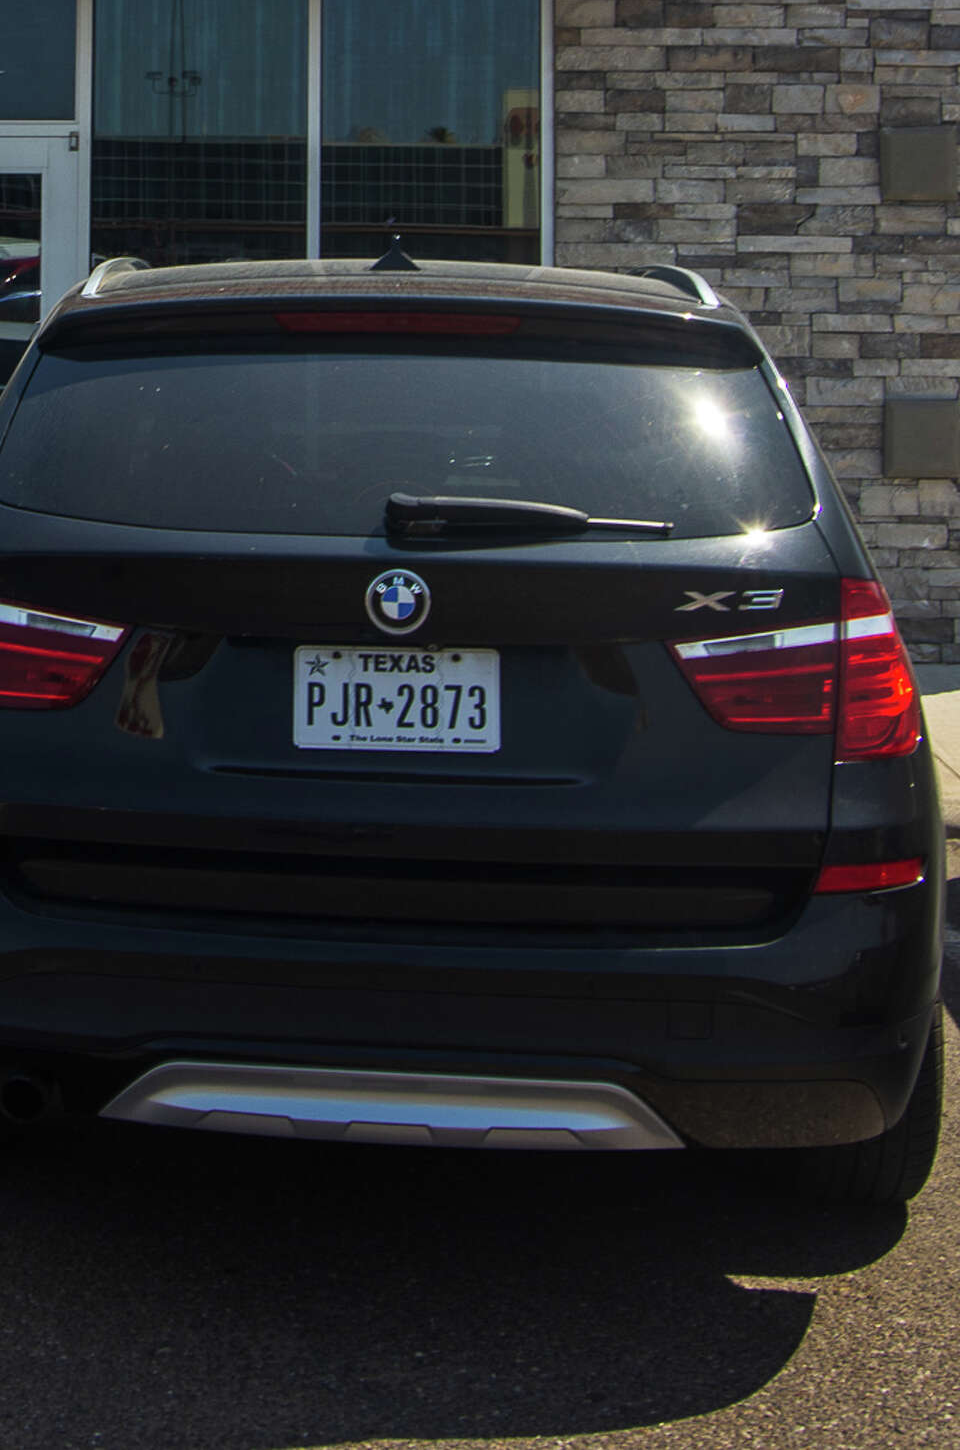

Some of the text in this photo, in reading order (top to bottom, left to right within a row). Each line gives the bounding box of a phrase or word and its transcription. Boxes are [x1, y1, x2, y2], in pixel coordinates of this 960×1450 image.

[375, 576, 423, 596] BMW
[673, 588, 784, 612] X3
[358, 653, 436, 674] TEXAS
[350, 734, 444, 743] The Lone Star State
